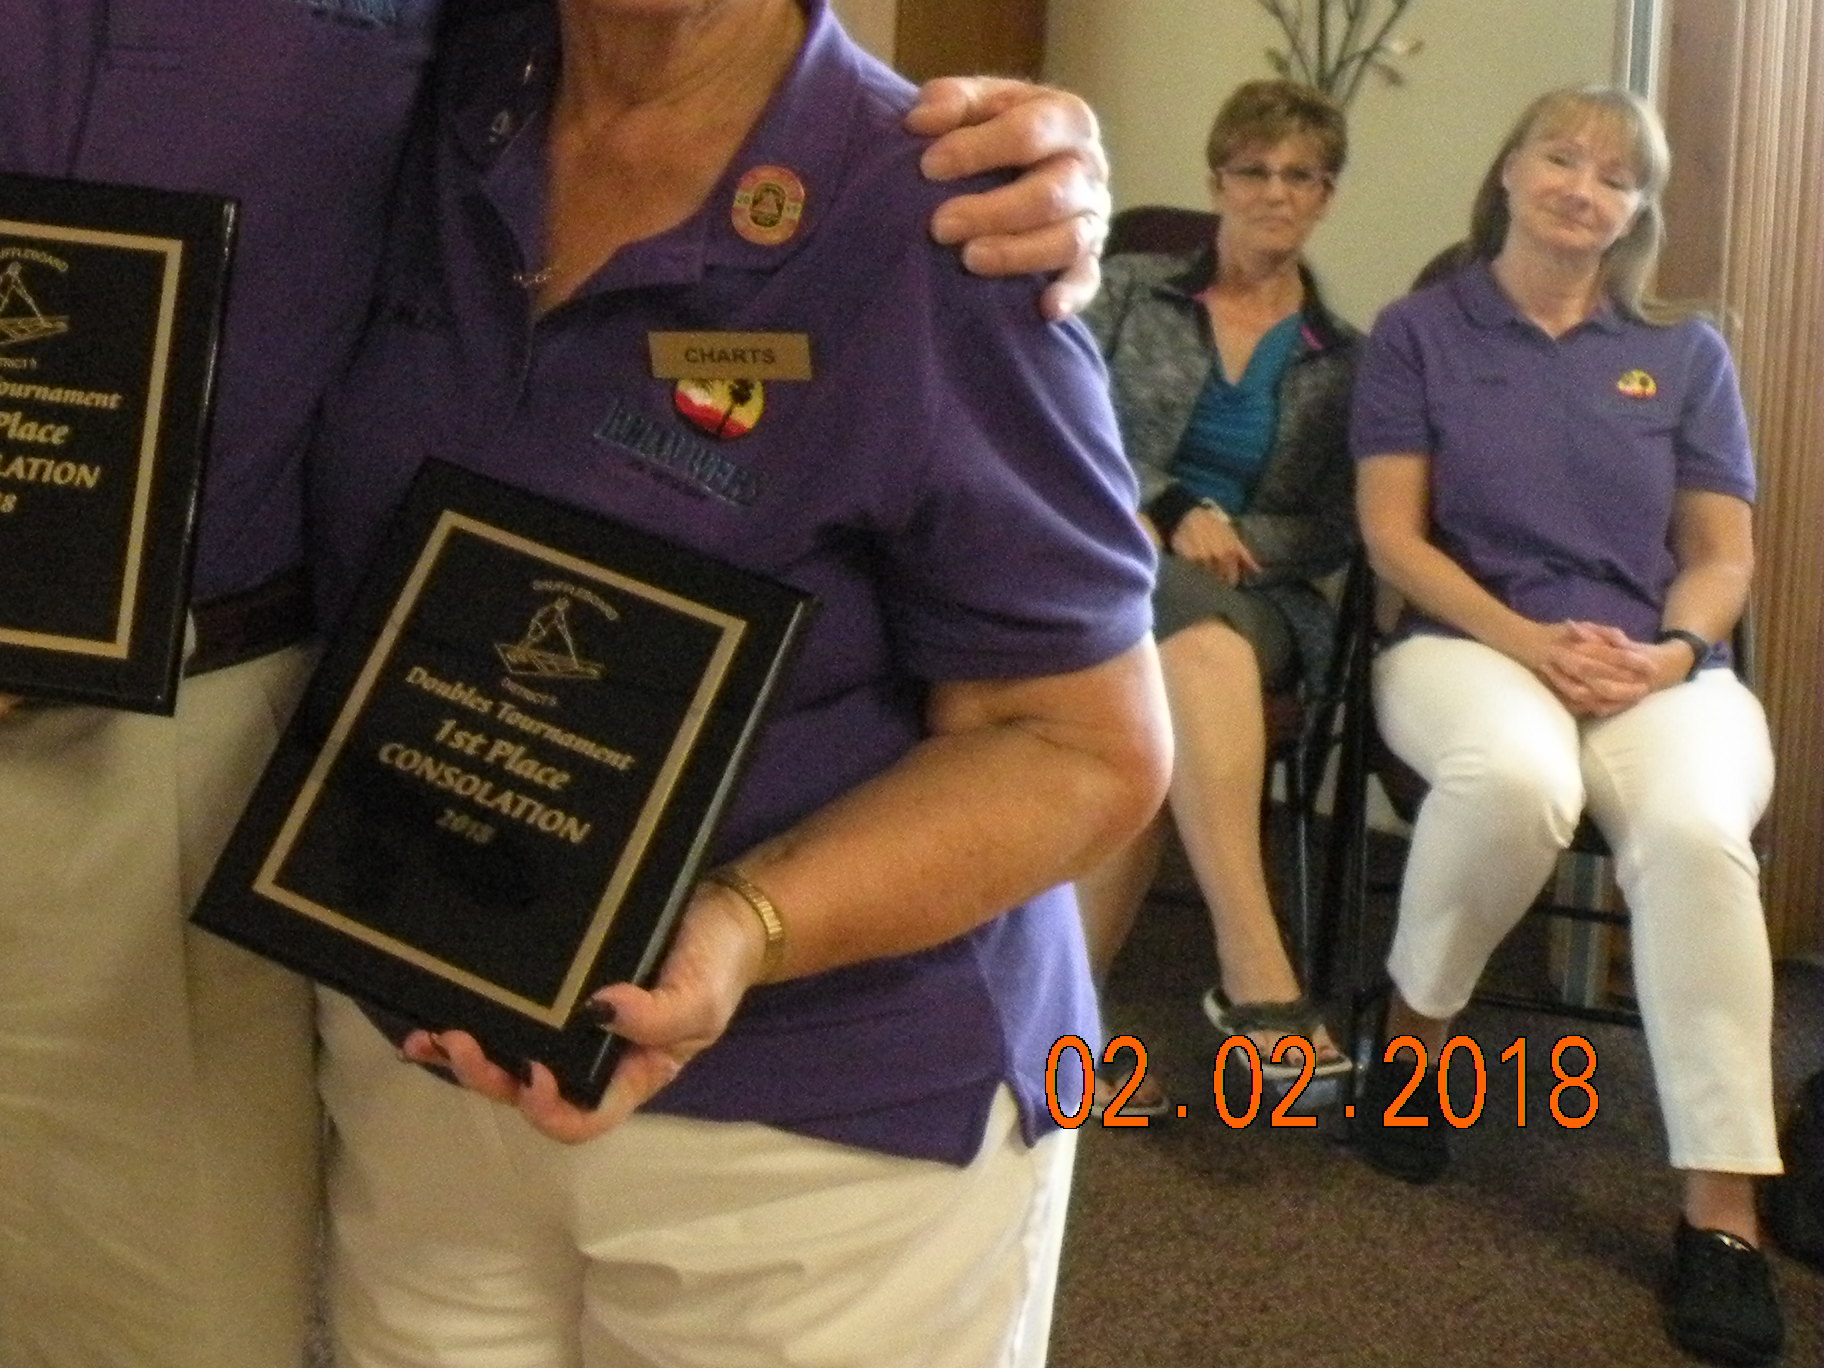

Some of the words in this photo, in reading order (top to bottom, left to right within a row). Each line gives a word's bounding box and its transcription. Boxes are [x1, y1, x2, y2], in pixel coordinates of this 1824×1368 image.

[684, 347, 776, 366] CHARTS
[405, 665, 492, 714] Doubles
[496, 703, 636, 771] Tournament
[435, 719, 486, 755] 1st
[487, 739, 571, 791] Place
[379, 742, 591, 844] CONSOLATION
[436, 809, 497, 844] 2018
